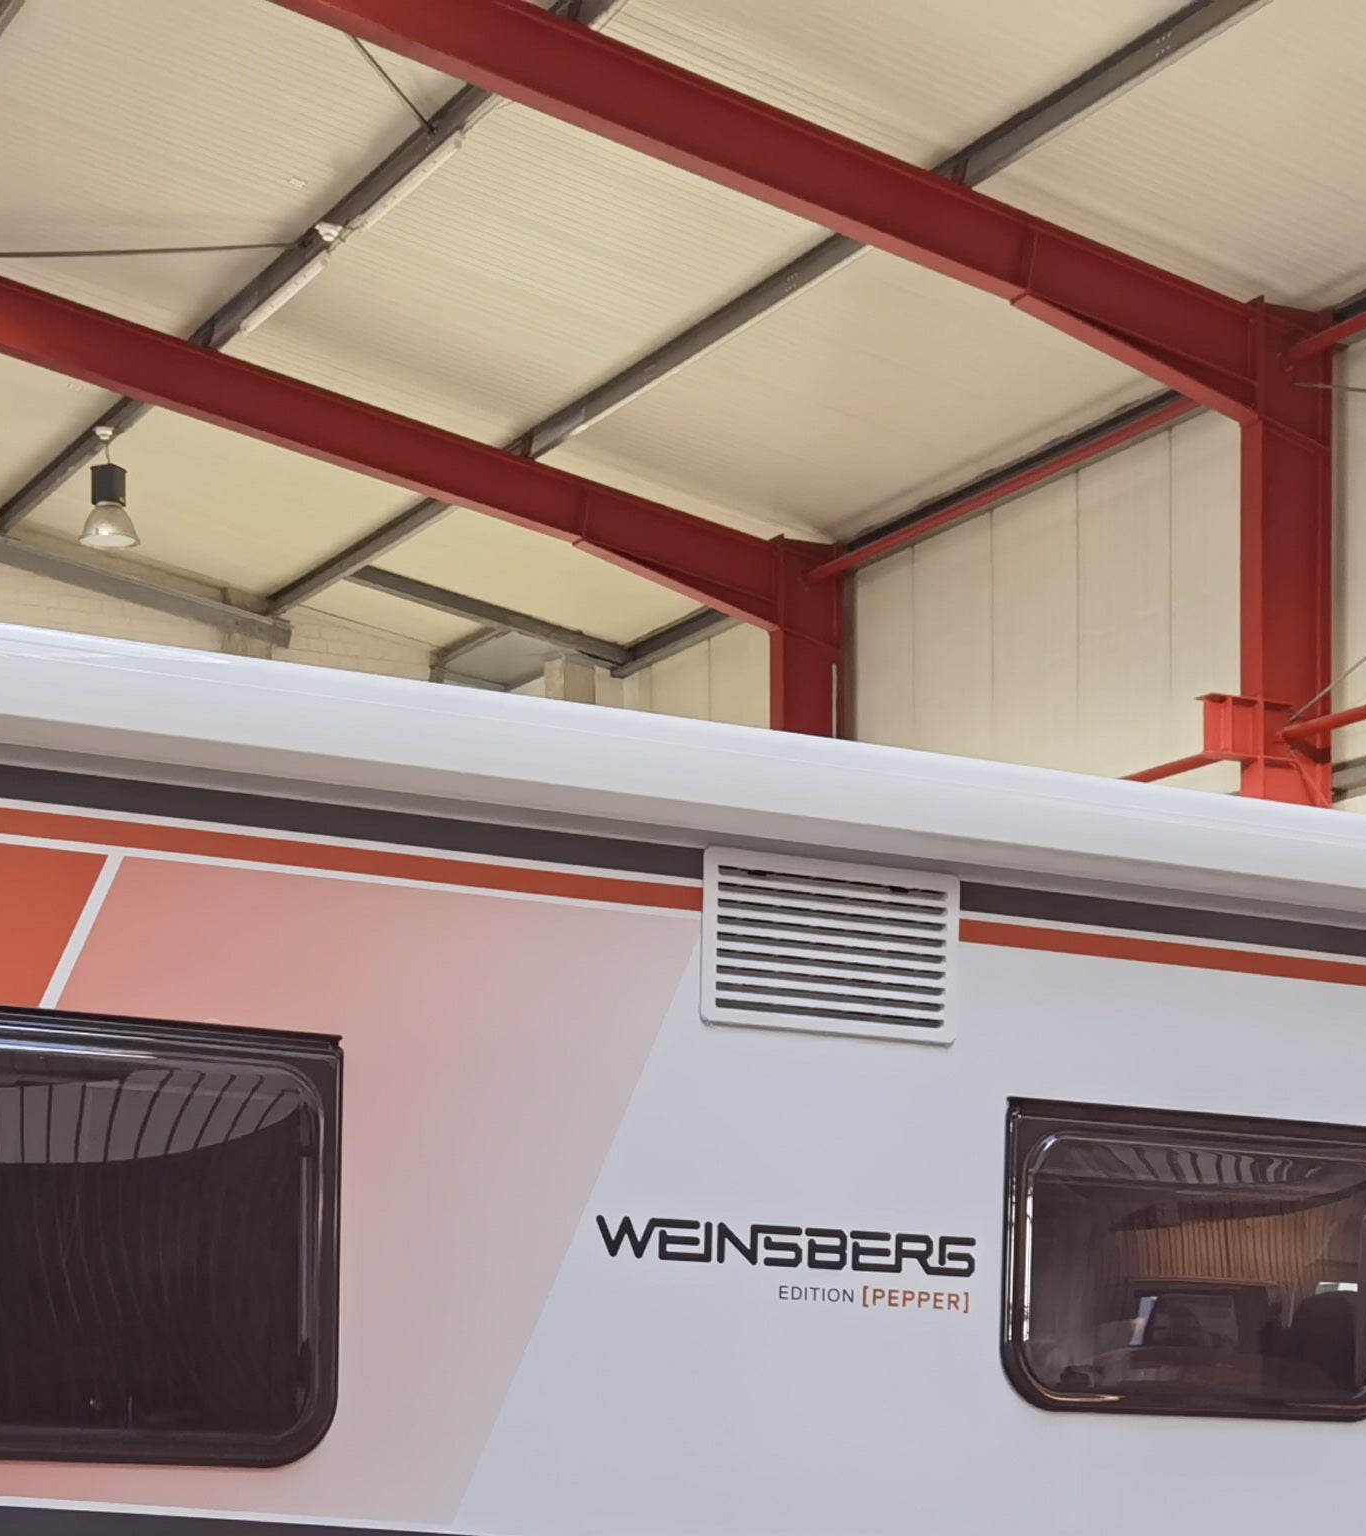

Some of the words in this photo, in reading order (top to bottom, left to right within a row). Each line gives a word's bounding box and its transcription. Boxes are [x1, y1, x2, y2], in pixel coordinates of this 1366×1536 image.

[596, 1214, 976, 1277] WEINSBERG
[778, 1285, 855, 1303] EDITION
[862, 1286, 970, 1313] [PEPPER]
